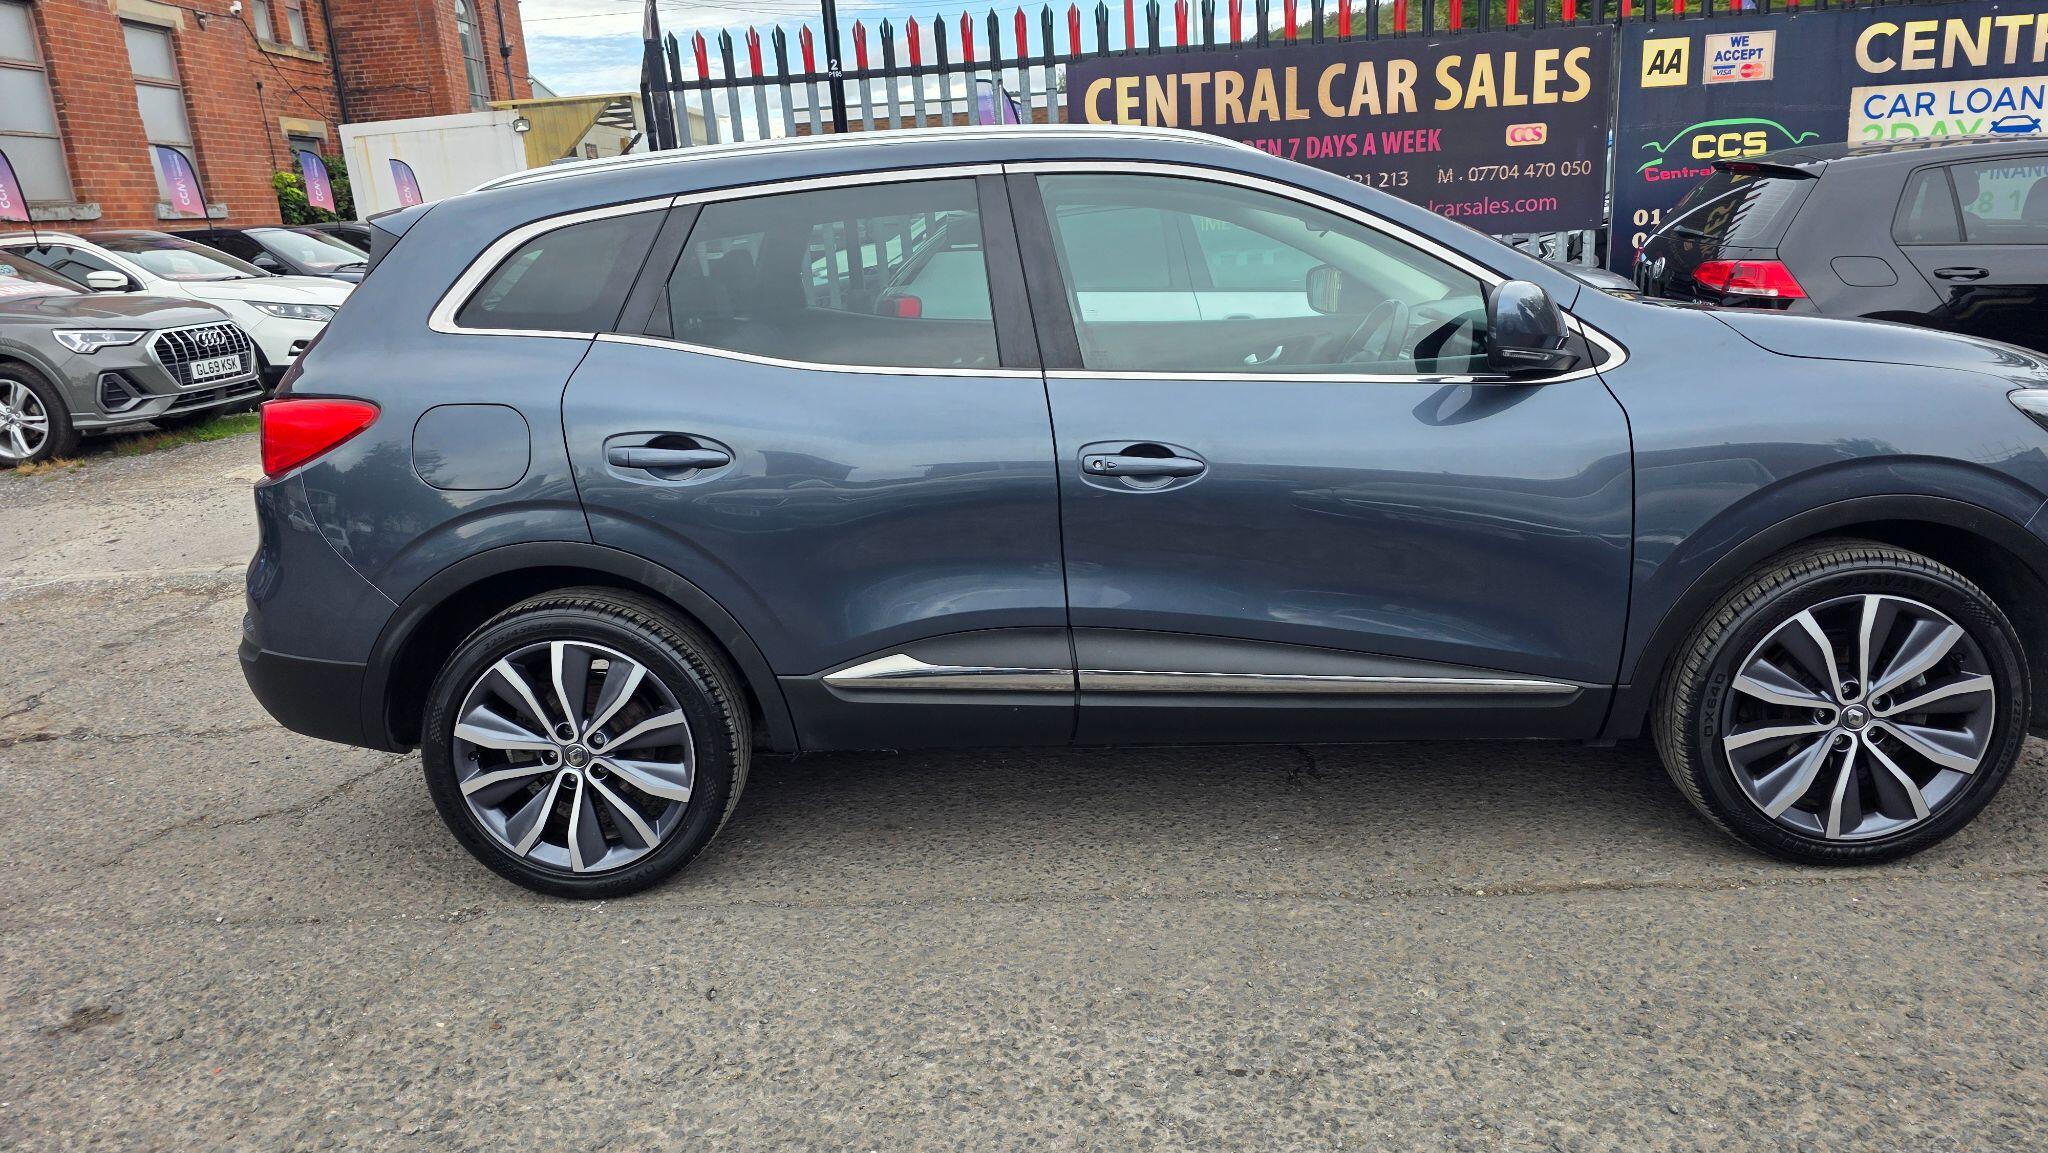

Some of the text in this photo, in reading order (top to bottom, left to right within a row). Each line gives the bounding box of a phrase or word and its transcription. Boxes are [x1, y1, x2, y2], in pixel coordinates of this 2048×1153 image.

[1714, 48, 1764, 61] ACCEPT
[1731, 36, 1749, 47] WE
[830, 59, 839, 71] 2
[1647, 49, 1682, 75] AA
[1085, 46, 1592, 128] CENTRAL CAR SALES
[1863, 85, 2045, 120] CAR LOAN
[1288, 137, 1300, 160] 7
[1306, 131, 1358, 159] DAYS
[1363, 132, 1376, 155] A
[1381, 128, 1442, 153] WEEK
[1692, 131, 1767, 159] CCS
[1378, 171, 1409, 188] 213
[1468, 165, 1519, 181] 07704
[1524, 163, 1555, 178] 470
[1561, 160, 1592, 176] 050
[196, 357, 237, 376] GL69 KSK
